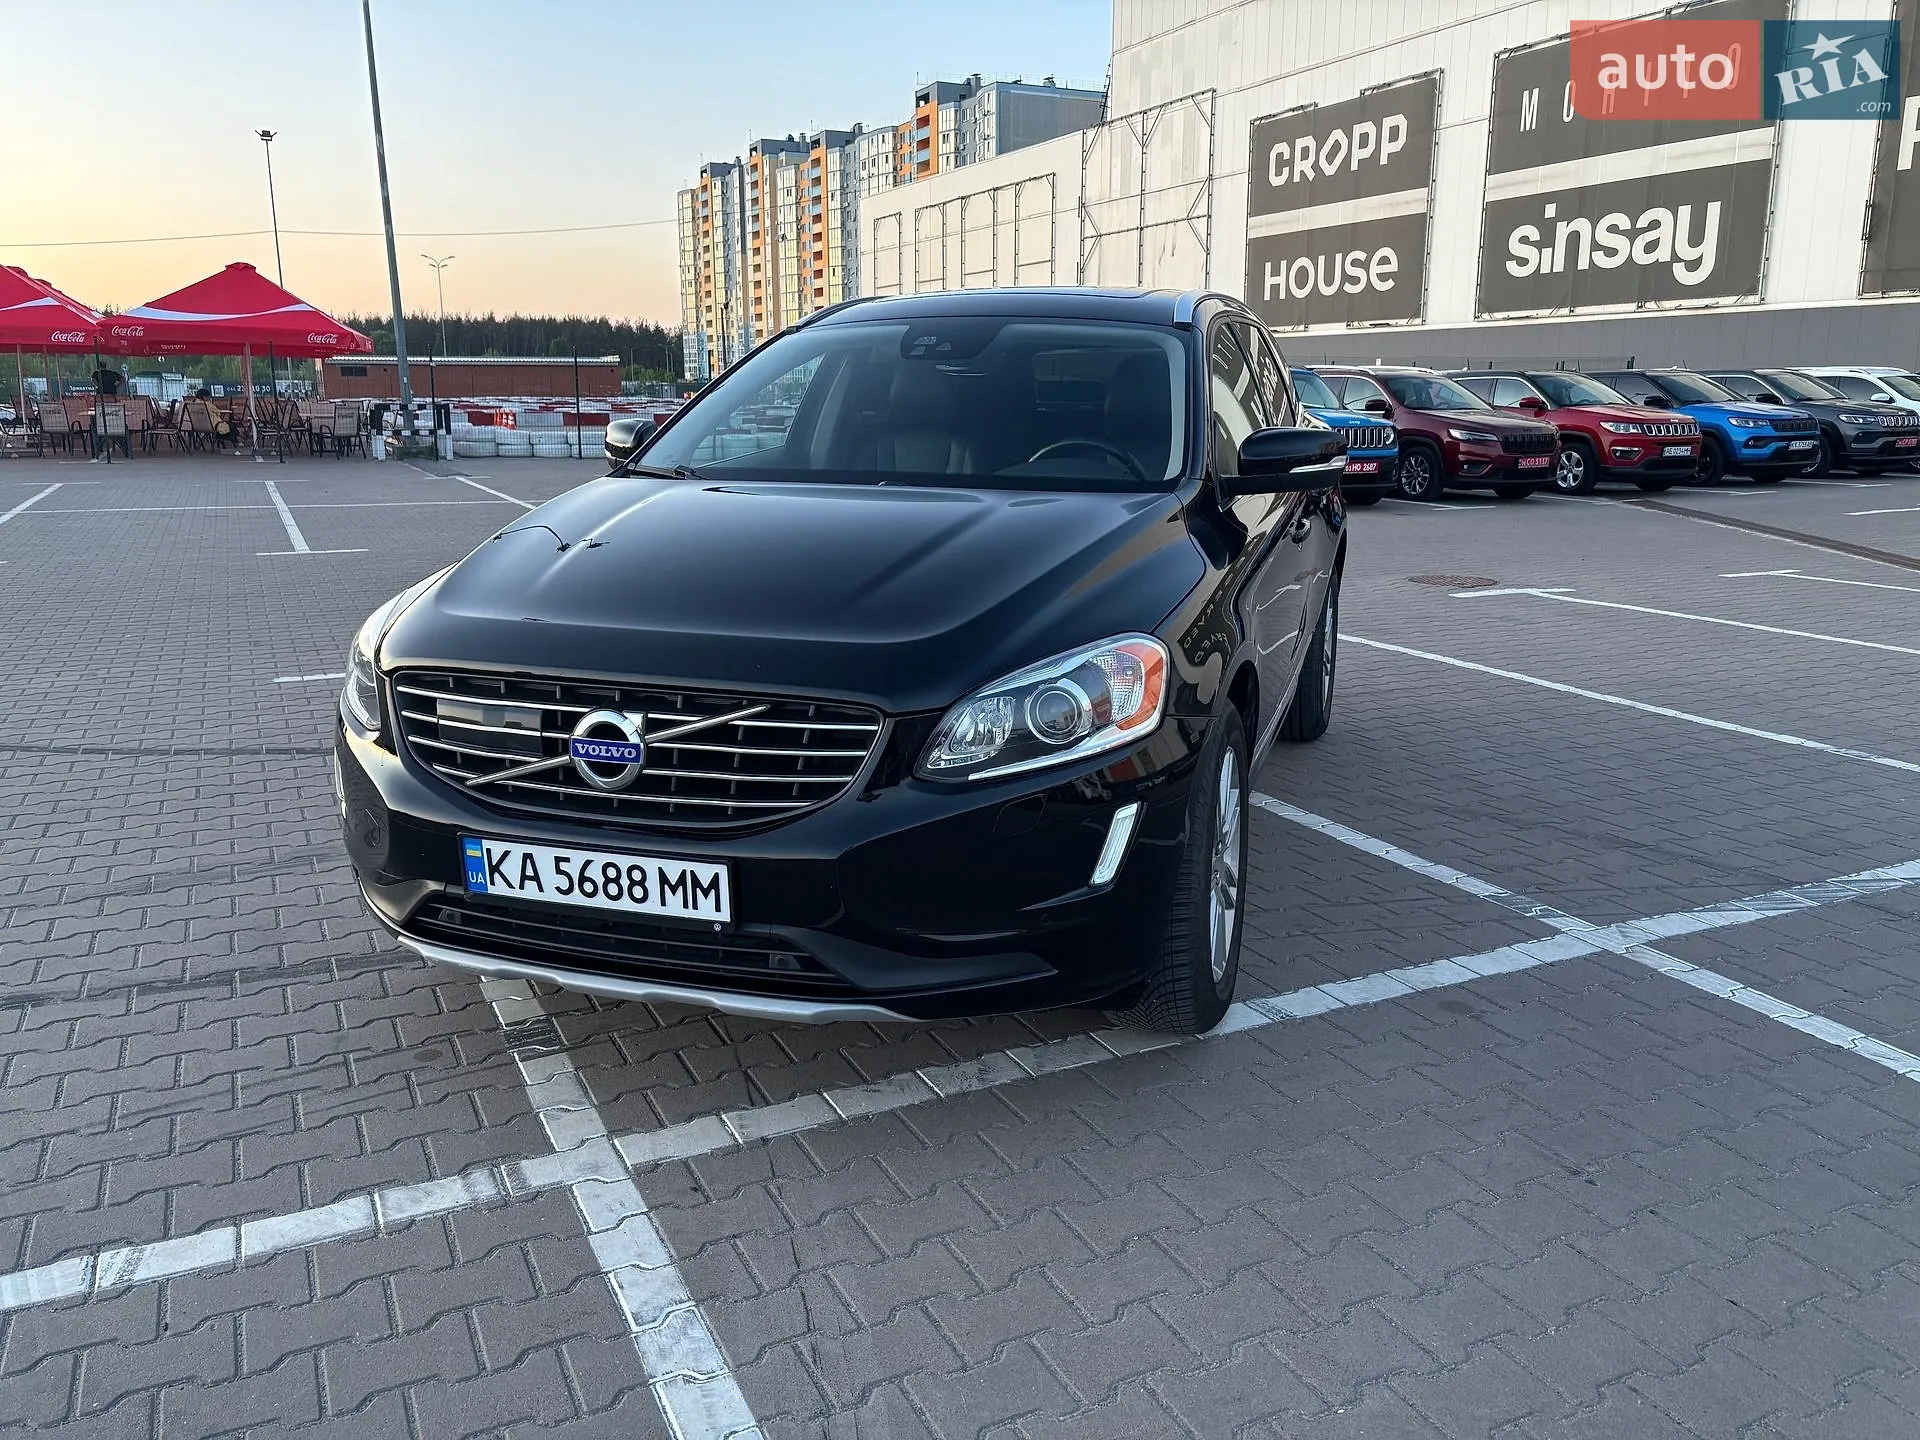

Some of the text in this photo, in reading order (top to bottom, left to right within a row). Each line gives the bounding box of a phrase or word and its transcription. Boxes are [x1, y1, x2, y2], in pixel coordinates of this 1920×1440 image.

[1268, 113, 1408, 187] CROPP
[1505, 200, 1722, 286] sinsay
[574, 742, 638, 760] VOLVO
[468, 870, 486, 885] UA
[485, 847, 722, 913] KA 5688 MM
